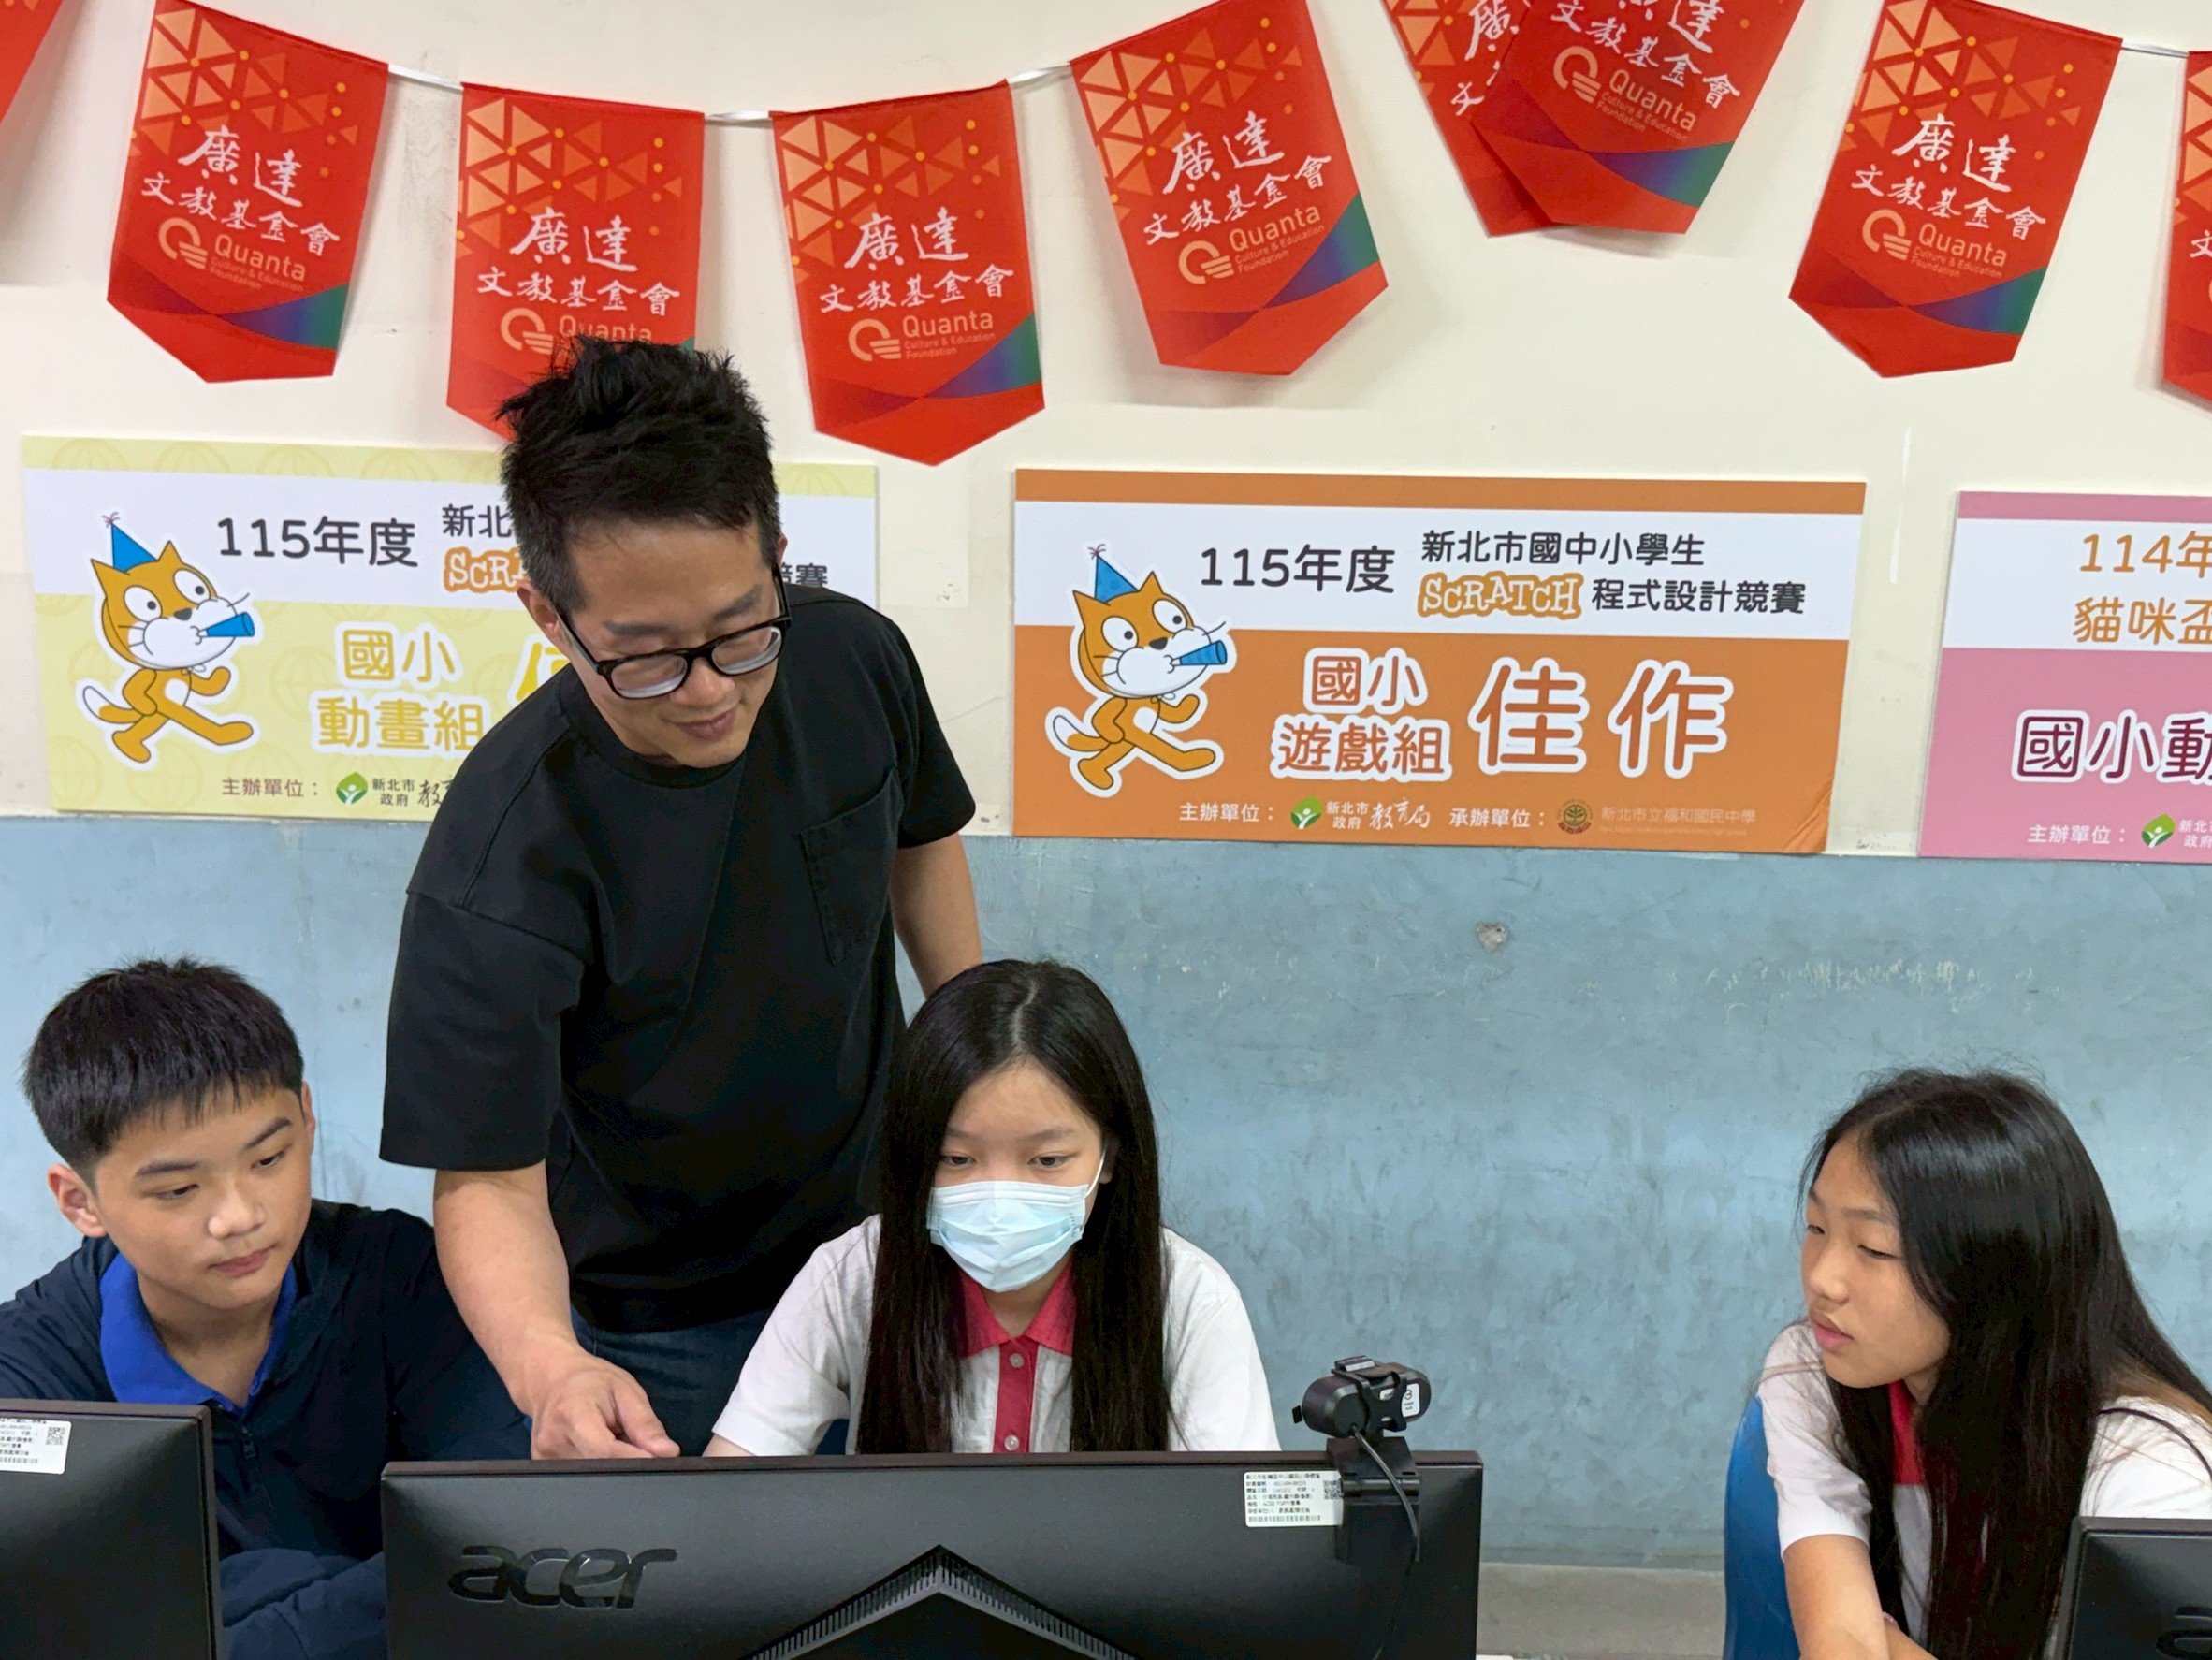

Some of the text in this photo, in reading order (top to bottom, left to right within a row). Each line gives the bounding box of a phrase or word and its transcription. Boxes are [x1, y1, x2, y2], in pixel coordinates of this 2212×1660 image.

[1464, 0, 1531, 61] 廣
[1618, 0, 1713, 53] 達
[1550, 0, 1740, 109] 文教基金會
[1601, 92, 1636, 114] Culture
[1609, 69, 1696, 131] Quanta
[177, 124, 303, 208] 廣達
[1162, 110, 1285, 195] 廣達
[1891, 112, 2016, 193] 廣達
[141, 171, 341, 256] 文教基金會
[1143, 155, 1332, 245] 文教基金會
[1851, 163, 2046, 240] 文教基金會
[509, 206, 638, 272] 廣達
[844, 206, 969, 271] 廣達
[1229, 205, 1320, 252] Quanta
[1234, 247, 1270, 265] Culture
[1280, 224, 1325, 248] Education
[1918, 222, 2007, 268] Quanta
[214, 234, 306, 281] Quanta
[1238, 249, 1289, 273] Foundation
[1911, 256, 1960, 278] Foundation
[1914, 246, 1946, 264] Culture
[1957, 261, 2002, 279] Education
[477, 266, 680, 316] 文教基金會
[820, 263, 1013, 313] 文教基金會
[902, 310, 994, 338] Quanta
[906, 345, 957, 359] Foundation
[218, 515, 418, 567] 115年度
[1421, 530, 1706, 566] 新北市國中小學生
[2079, 530, 2212, 578] 114年
[1201, 543, 1395, 593] 115年度
[1592, 578, 1807, 615] 程式設計競賽
[2072, 596, 2212, 645] 貓咪盃
[342, 629, 456, 683] 國小
[1310, 654, 1420, 707] 國小
[316, 695, 484, 751] 動畫組
[1476, 664, 1725, 771] 佳作
[1277, 721, 1445, 776] 遊戲組
[2016, 715, 2212, 780] 國小動
[371, 777, 415, 793] 新北市
[379, 793, 409, 807] 政府
[417, 779, 454, 808] 教
[1326, 801, 1369, 816] 新北市
[1332, 816, 1361, 830] 政府
[1601, 805, 1756, 824] 新北市立福和國民中學
[2179, 819, 2212, 833] 新北
[448, 1545, 677, 1609] acer
